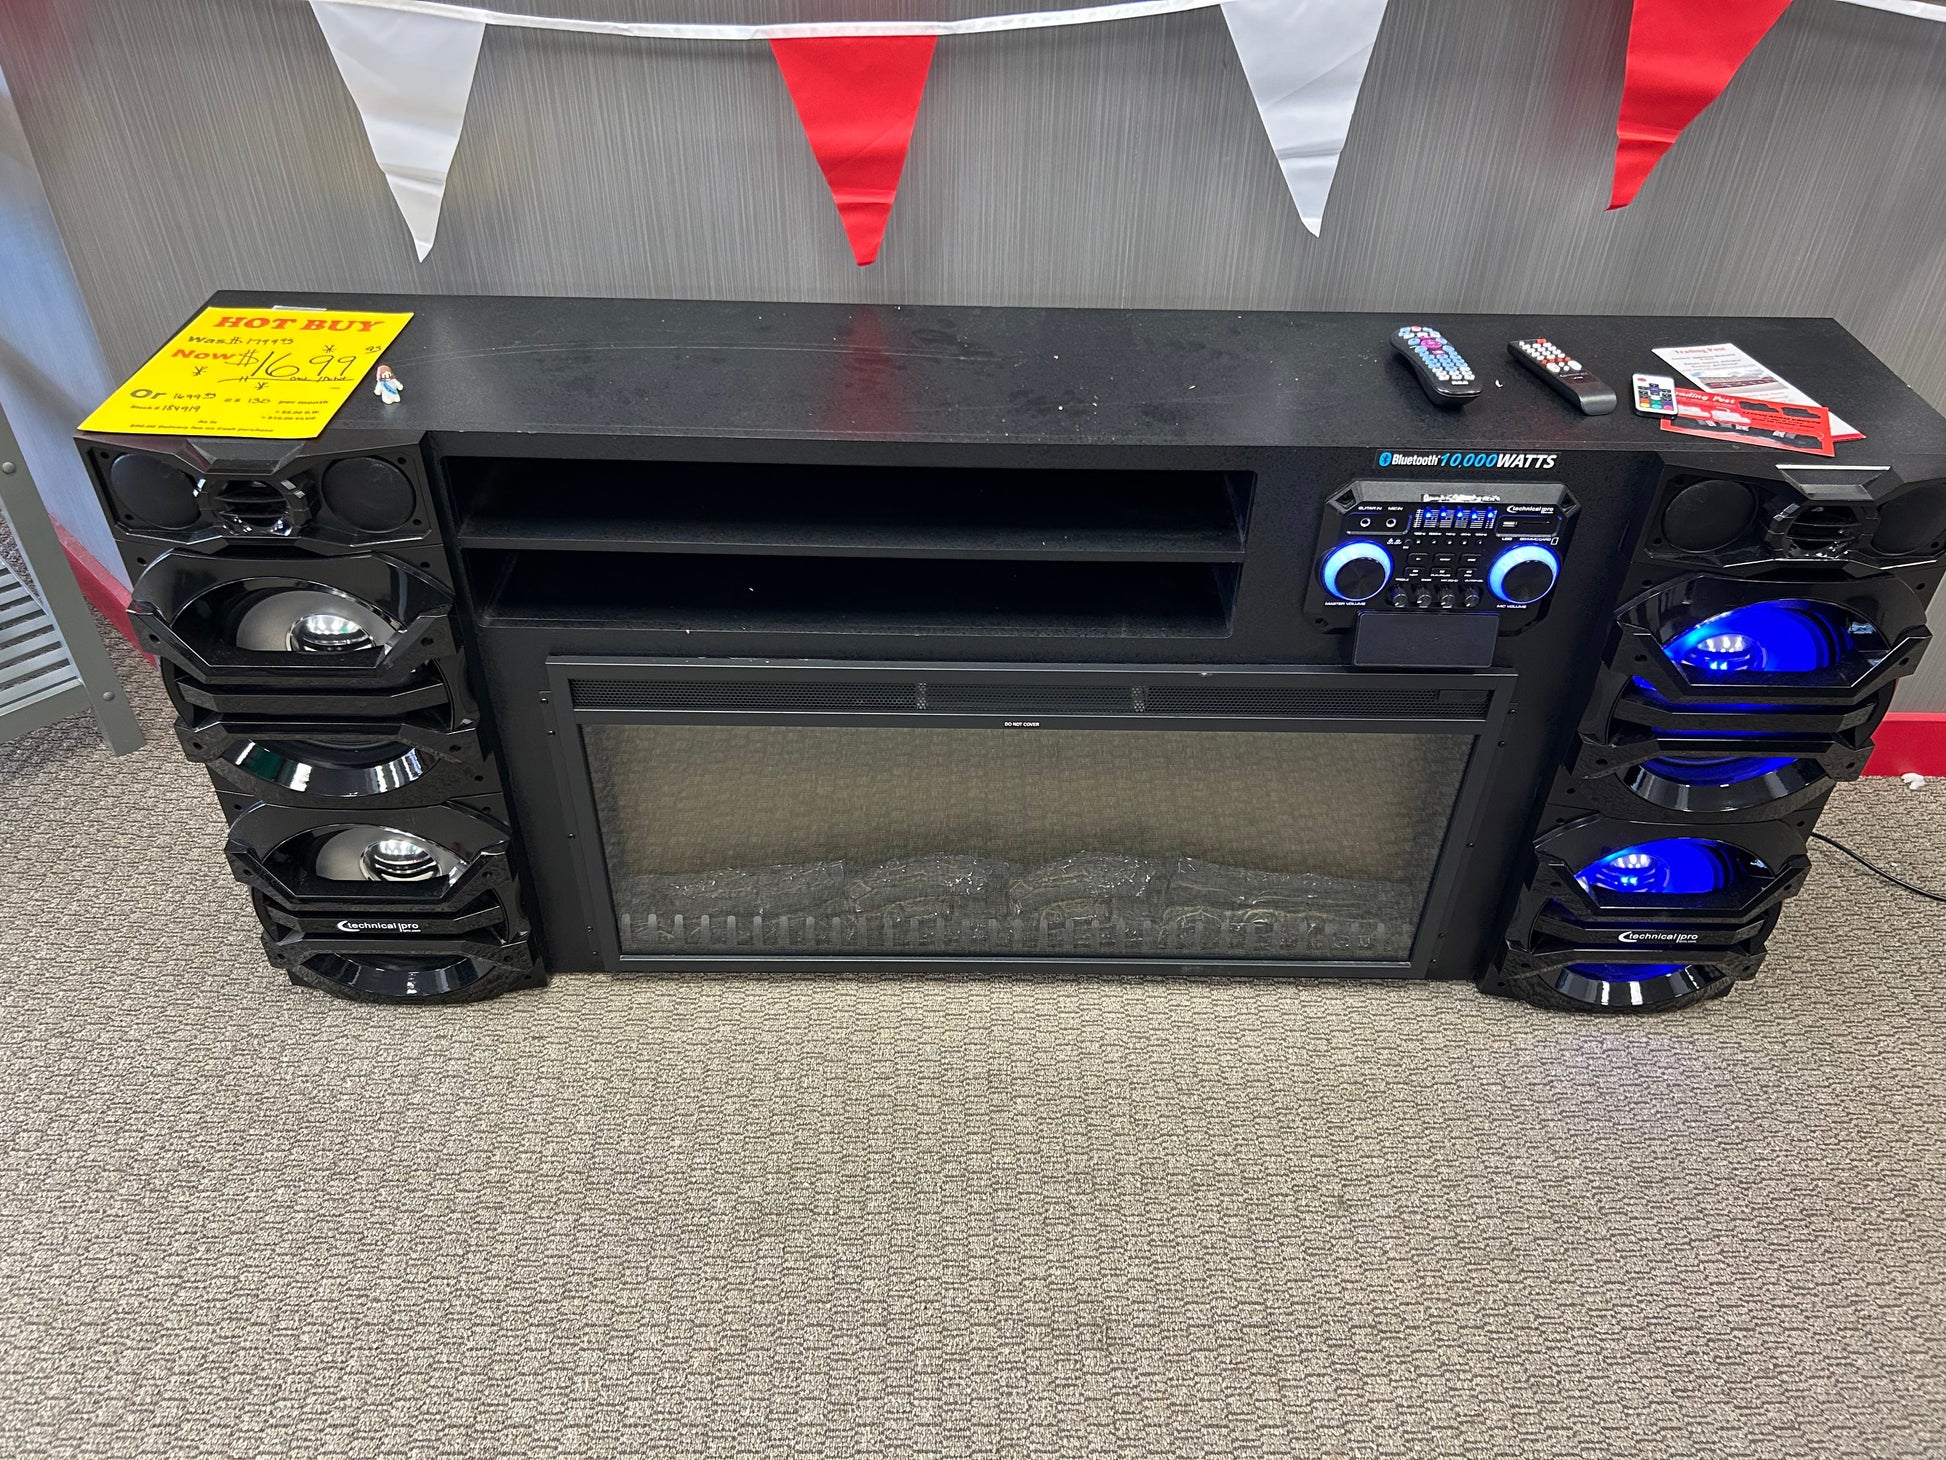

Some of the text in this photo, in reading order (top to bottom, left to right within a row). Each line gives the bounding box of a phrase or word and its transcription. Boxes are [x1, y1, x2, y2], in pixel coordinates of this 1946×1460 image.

[213, 316, 384, 332] HOT BUY
[188, 336, 226, 345] Was
[171, 349, 237, 361] Now
[130, 388, 167, 400] Or
[1675, 390, 1709, 401] rading
[1391, 453, 1439, 466] Bluetooth
